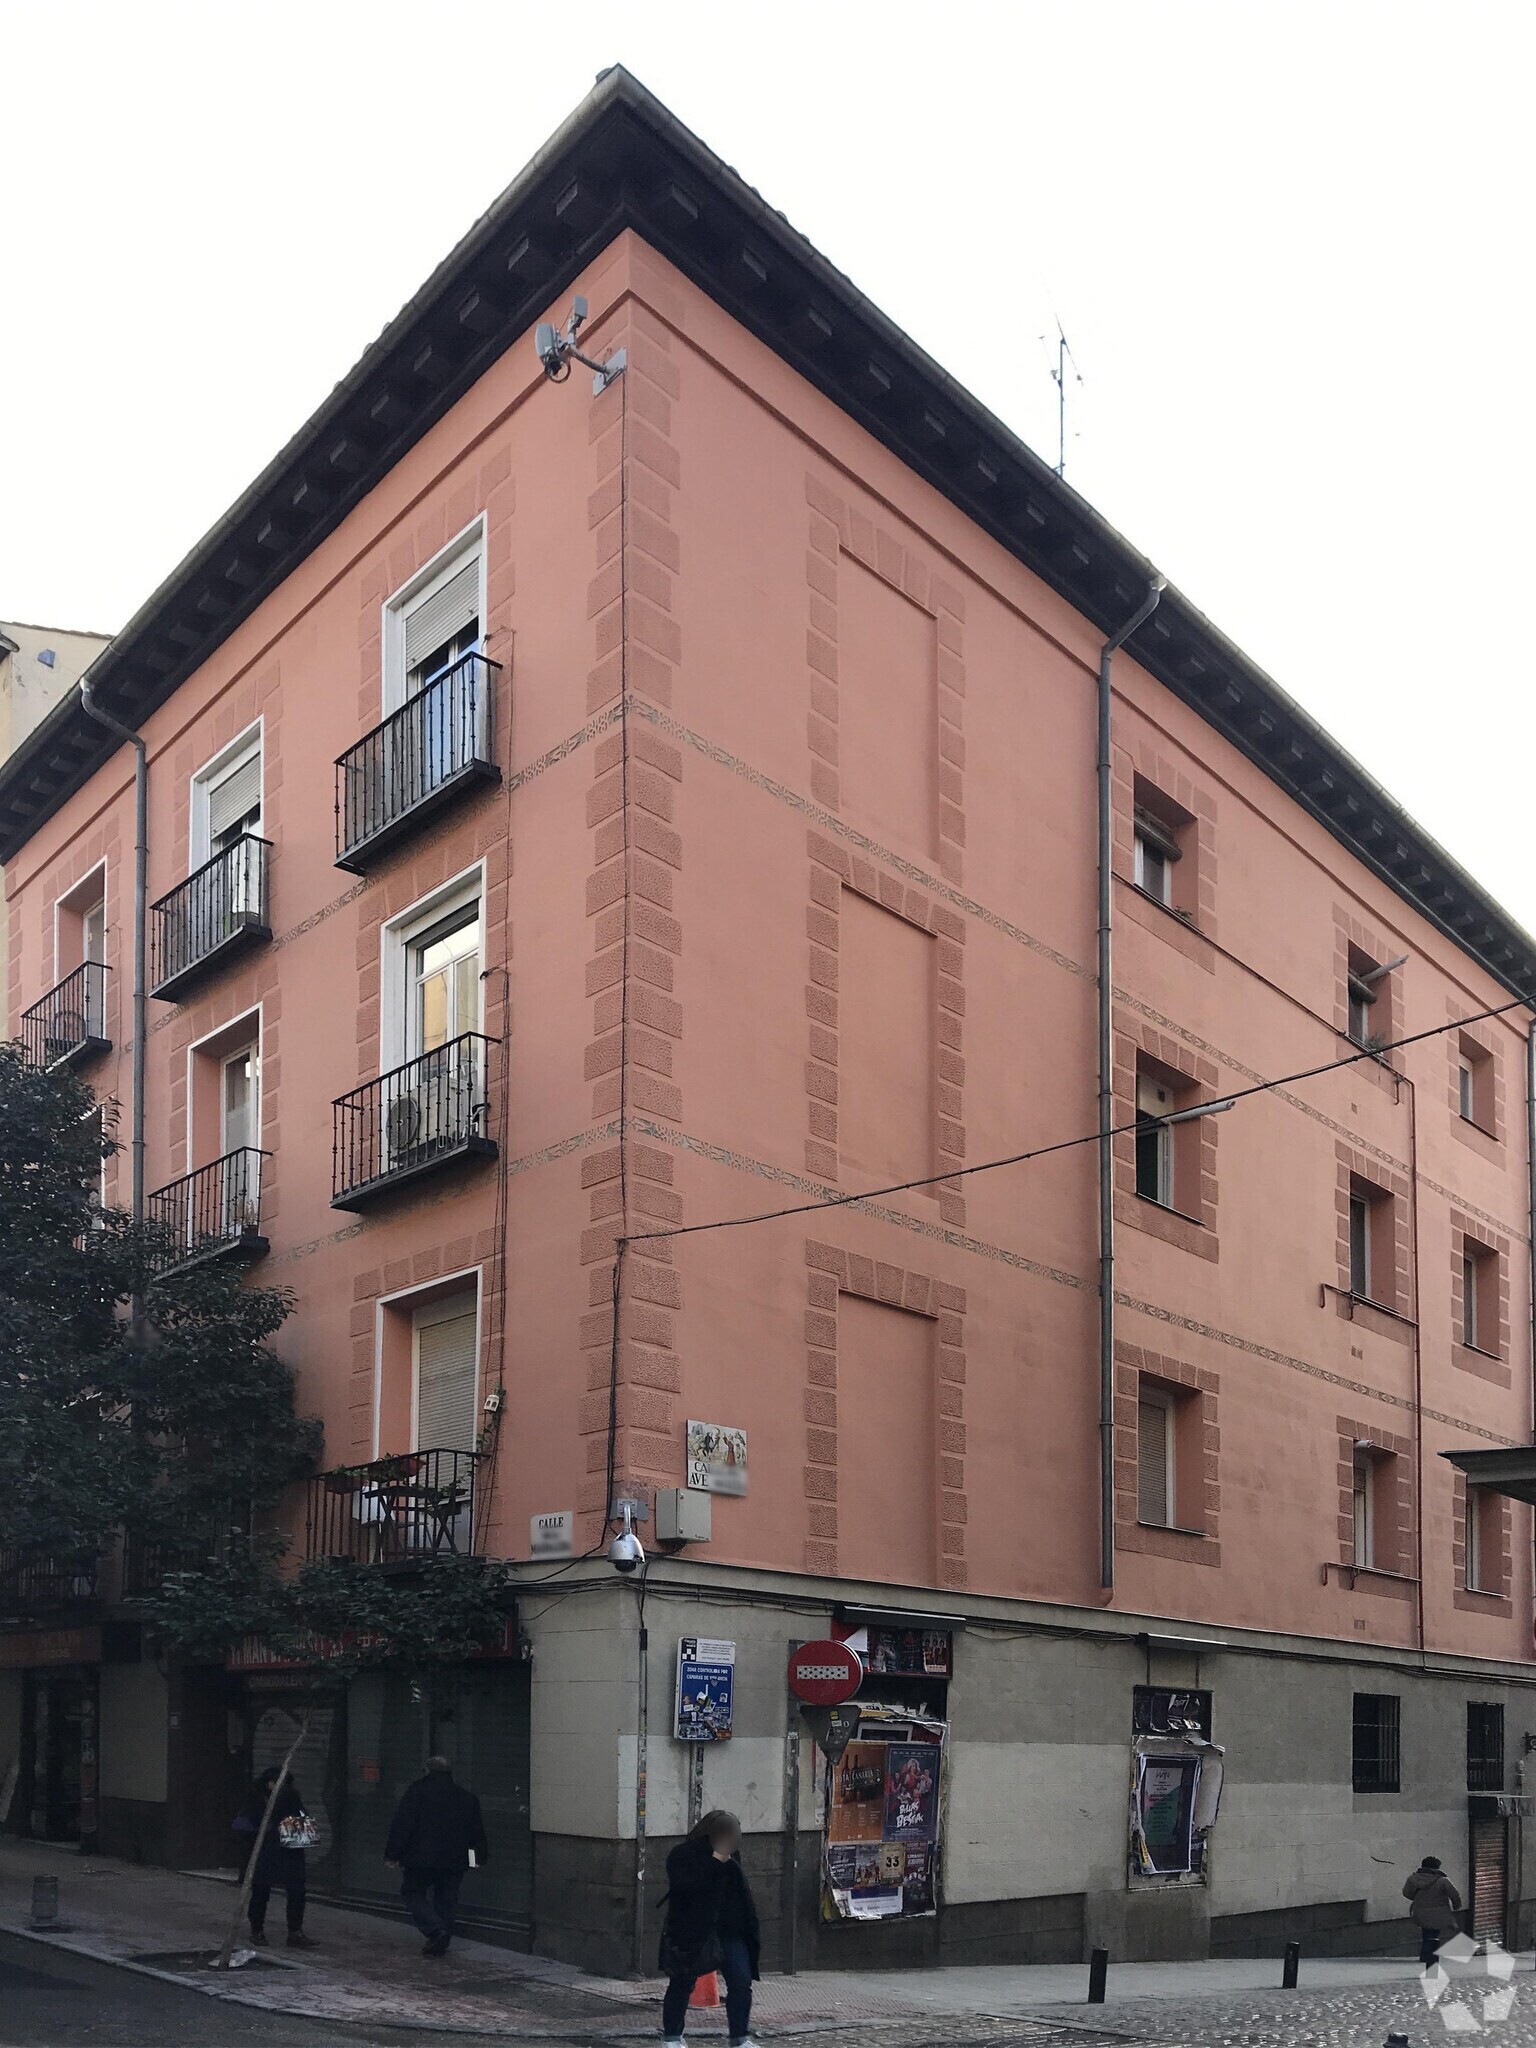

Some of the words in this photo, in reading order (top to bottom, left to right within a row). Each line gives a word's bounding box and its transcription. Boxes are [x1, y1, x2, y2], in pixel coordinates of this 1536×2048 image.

[689, 1473, 710, 1487] AVE
[538, 1516, 565, 1529] CALLE
[886, 1856, 900, 1868] 33
